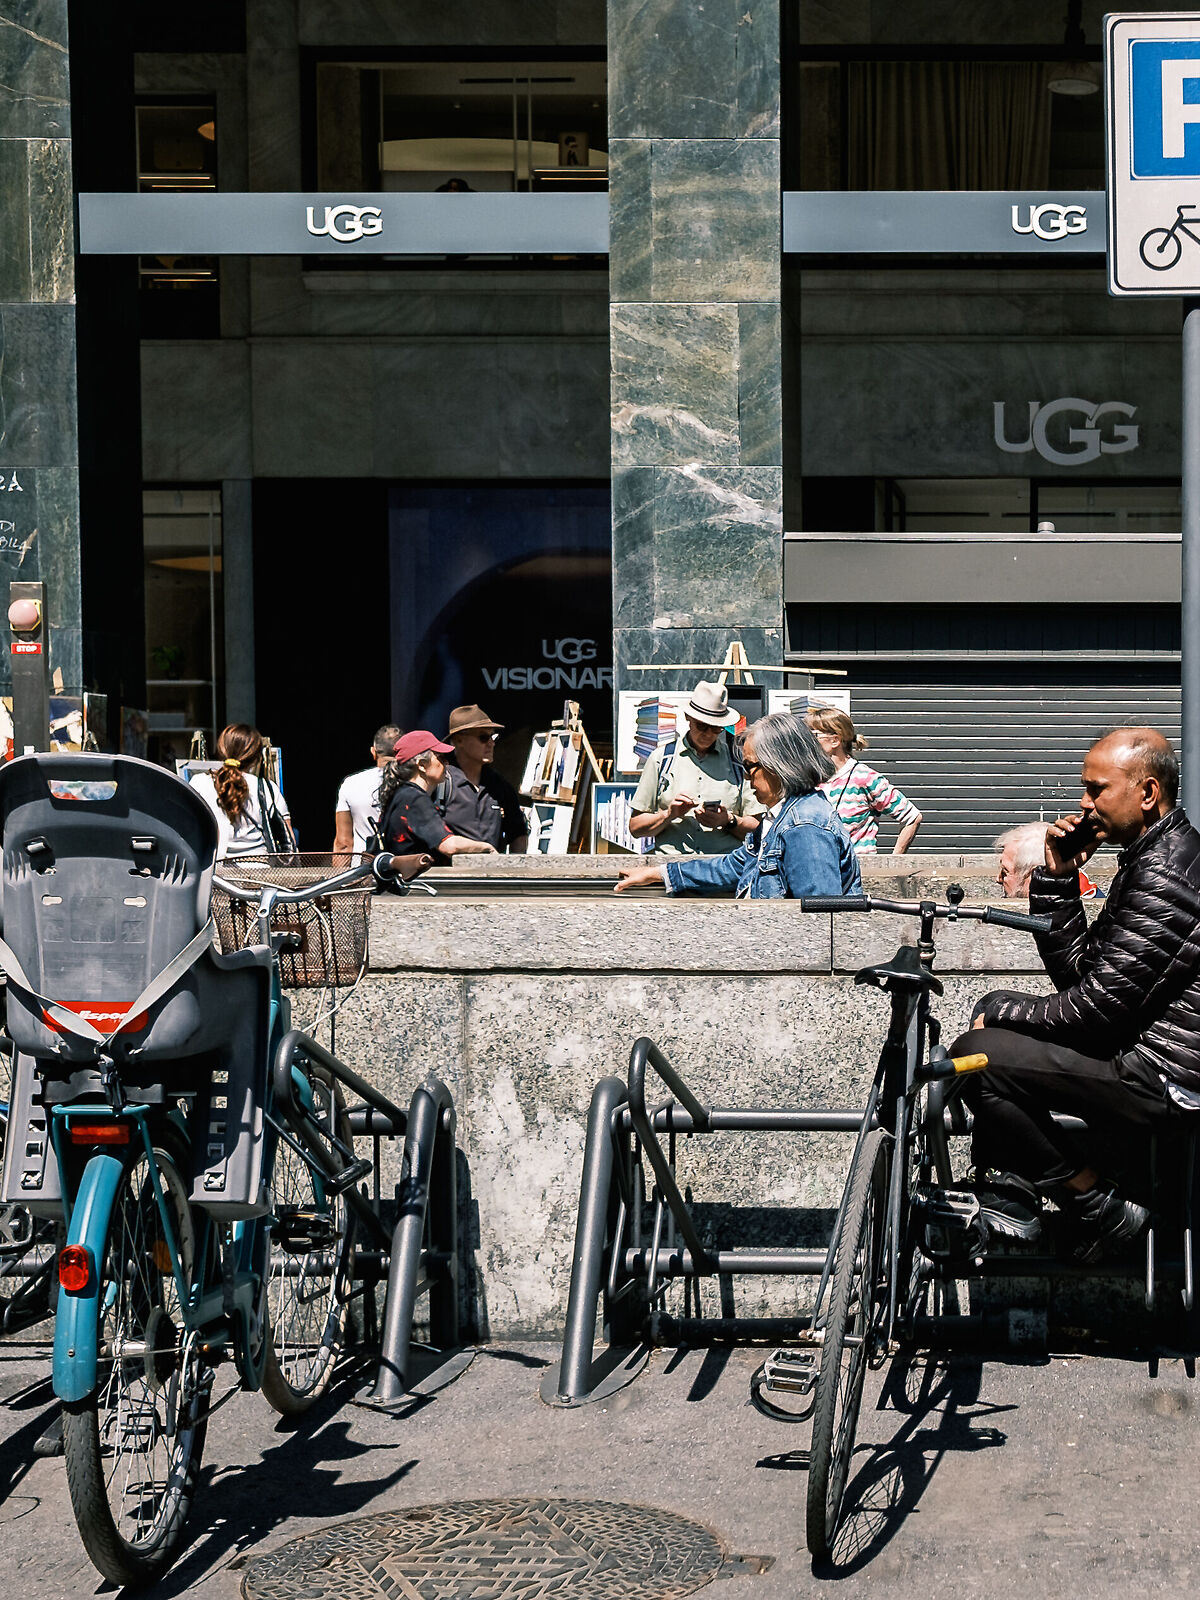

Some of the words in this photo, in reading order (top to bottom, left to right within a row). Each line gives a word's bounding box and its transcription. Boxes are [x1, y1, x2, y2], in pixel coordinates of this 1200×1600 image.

[306, 205, 382, 241] UGG
[1011, 204, 1088, 240] UGG
[993, 398, 1139, 466] UGG
[16, 645, 38, 653] STOP
[541, 638, 598, 664] UGG
